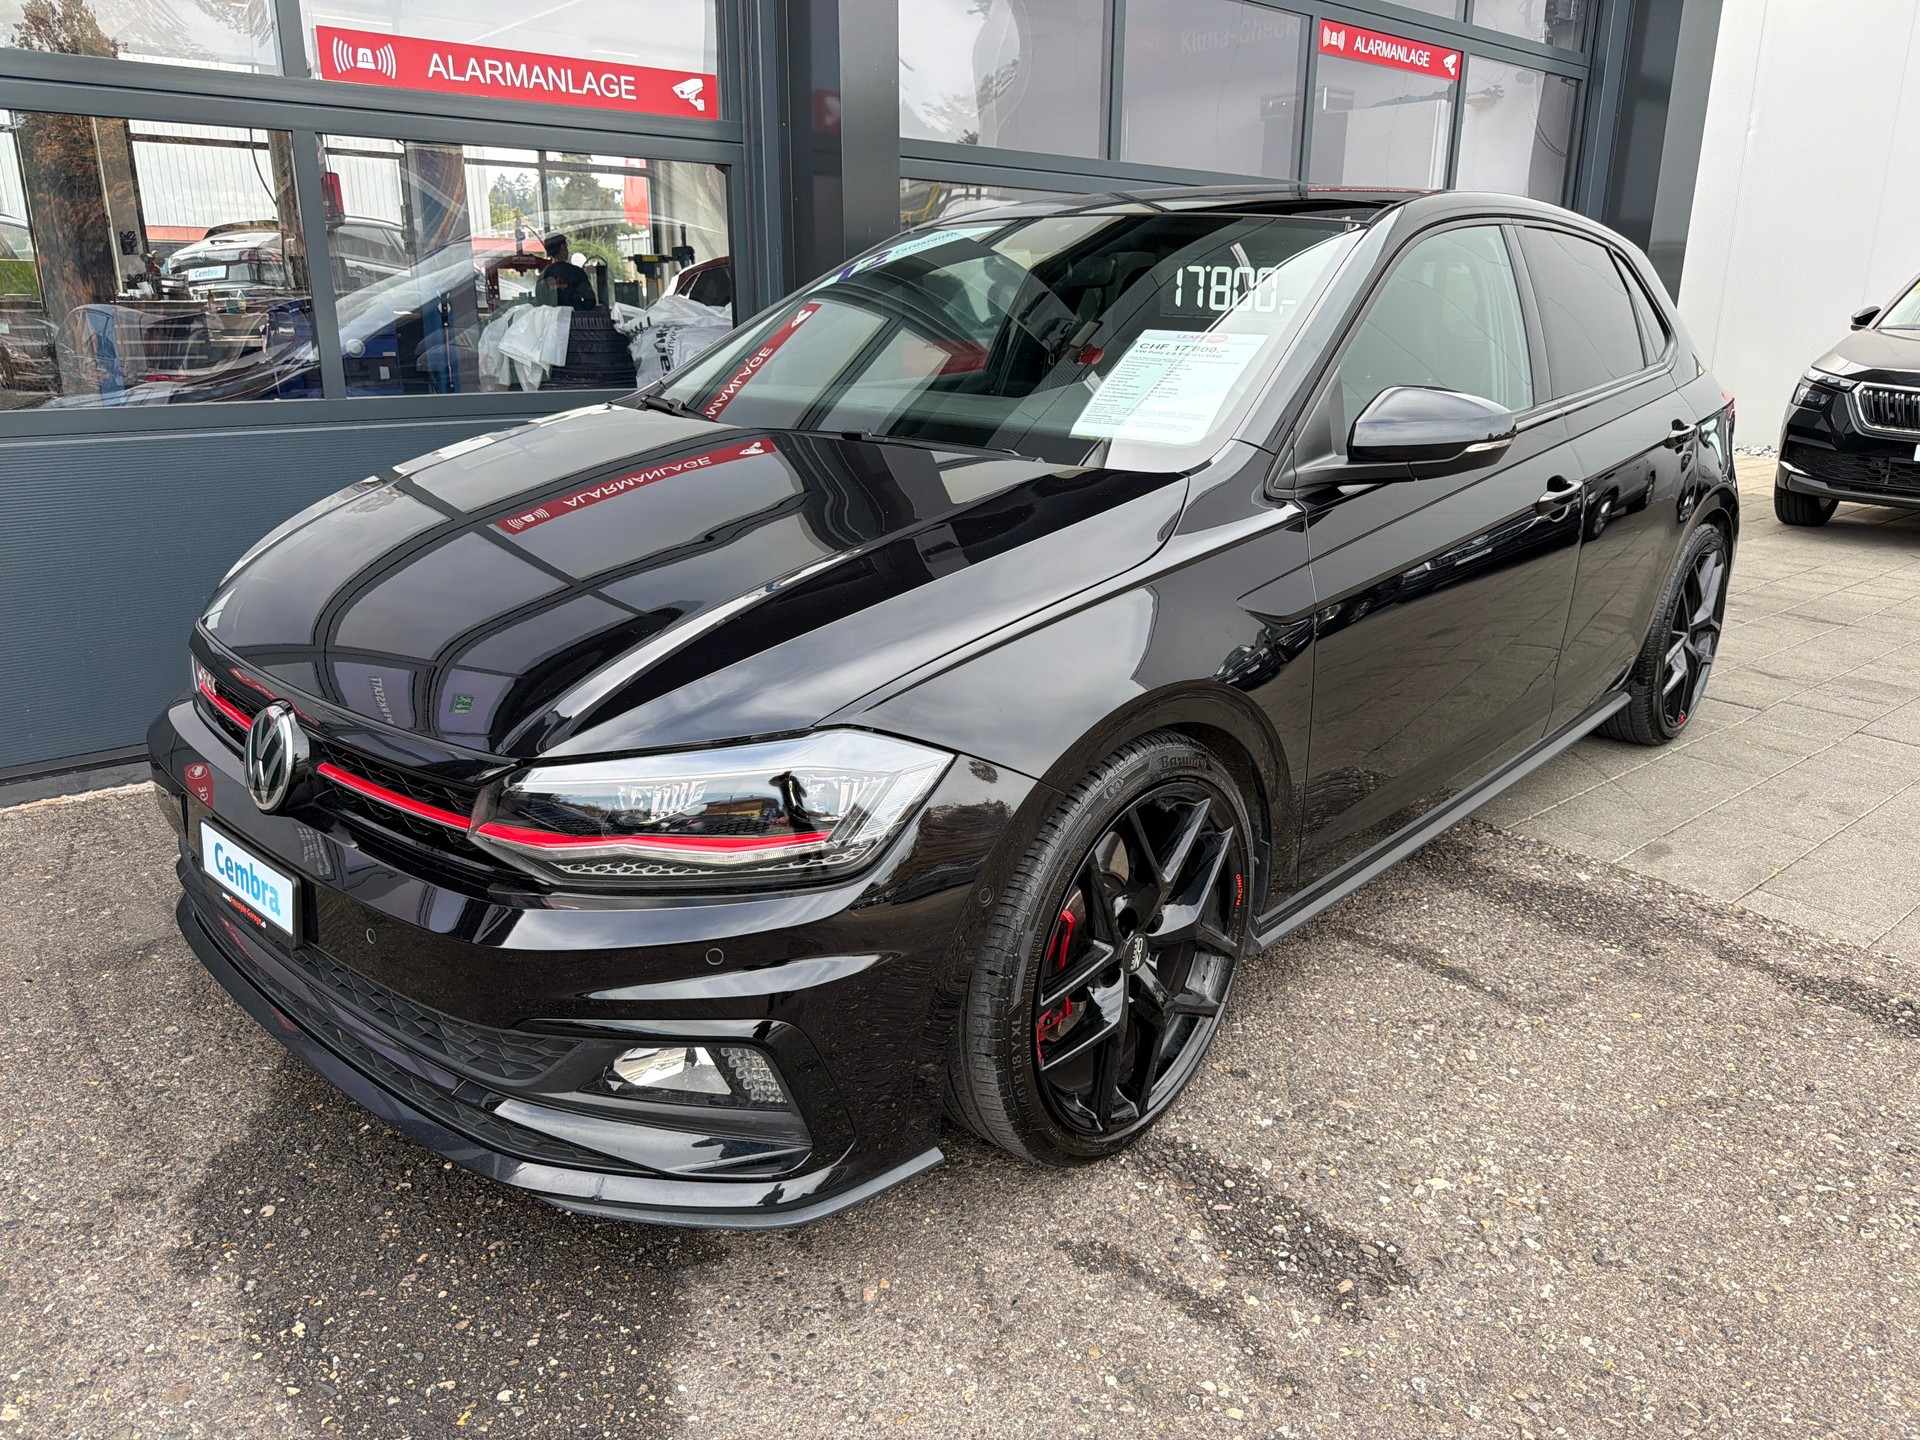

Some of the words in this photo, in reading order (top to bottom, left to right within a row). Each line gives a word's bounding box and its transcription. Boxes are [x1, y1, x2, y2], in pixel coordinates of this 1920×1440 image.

[1353, 35, 1432, 68] ALARMANLAGE
[427, 53, 638, 100] ALARMANLAGE
[1139, 342, 1170, 350] CHF
[214, 842, 281, 916] Cembra
